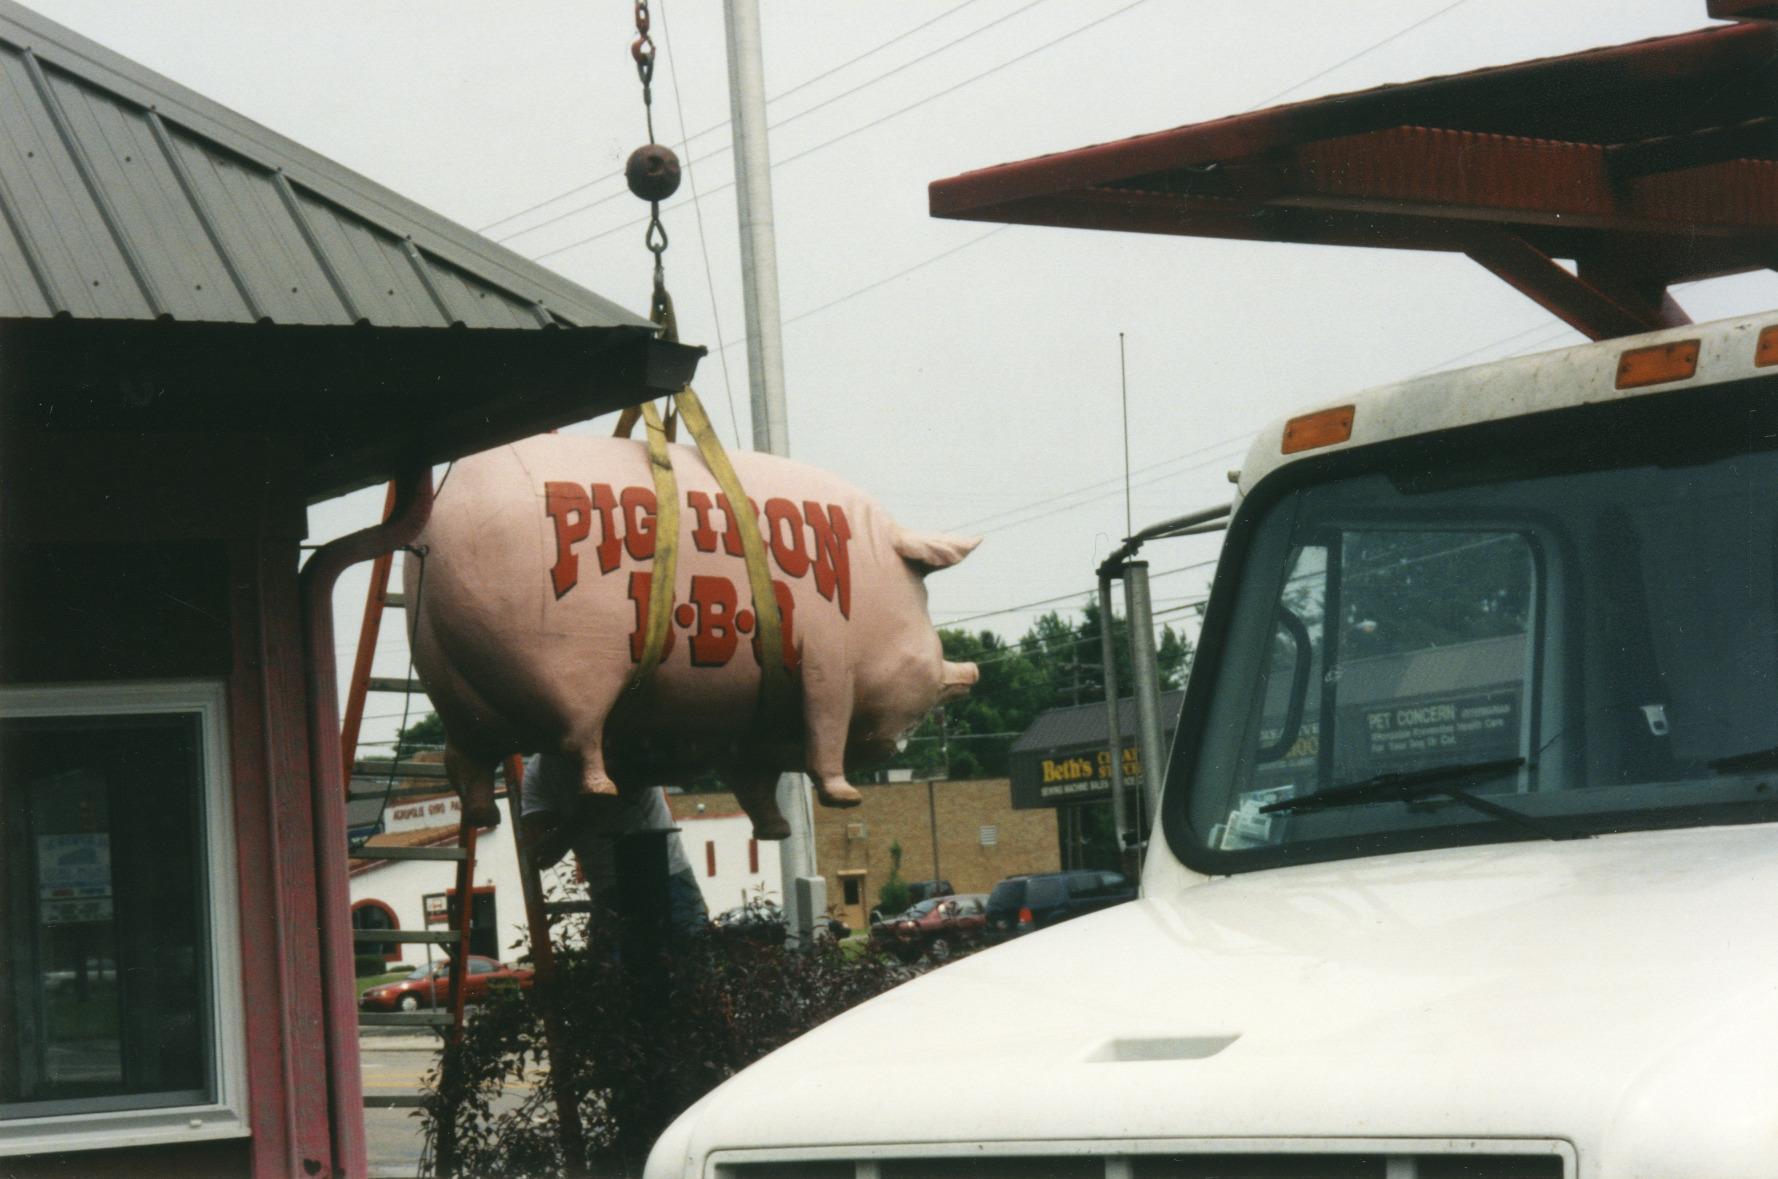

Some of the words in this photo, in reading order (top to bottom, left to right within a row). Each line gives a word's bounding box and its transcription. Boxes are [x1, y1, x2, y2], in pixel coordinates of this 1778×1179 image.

[544, 481, 660, 600] PIG
[1367, 712, 1393, 730] PET
[1396, 704, 1456, 727] CONCERN
[1041, 757, 1093, 783] Beth's
